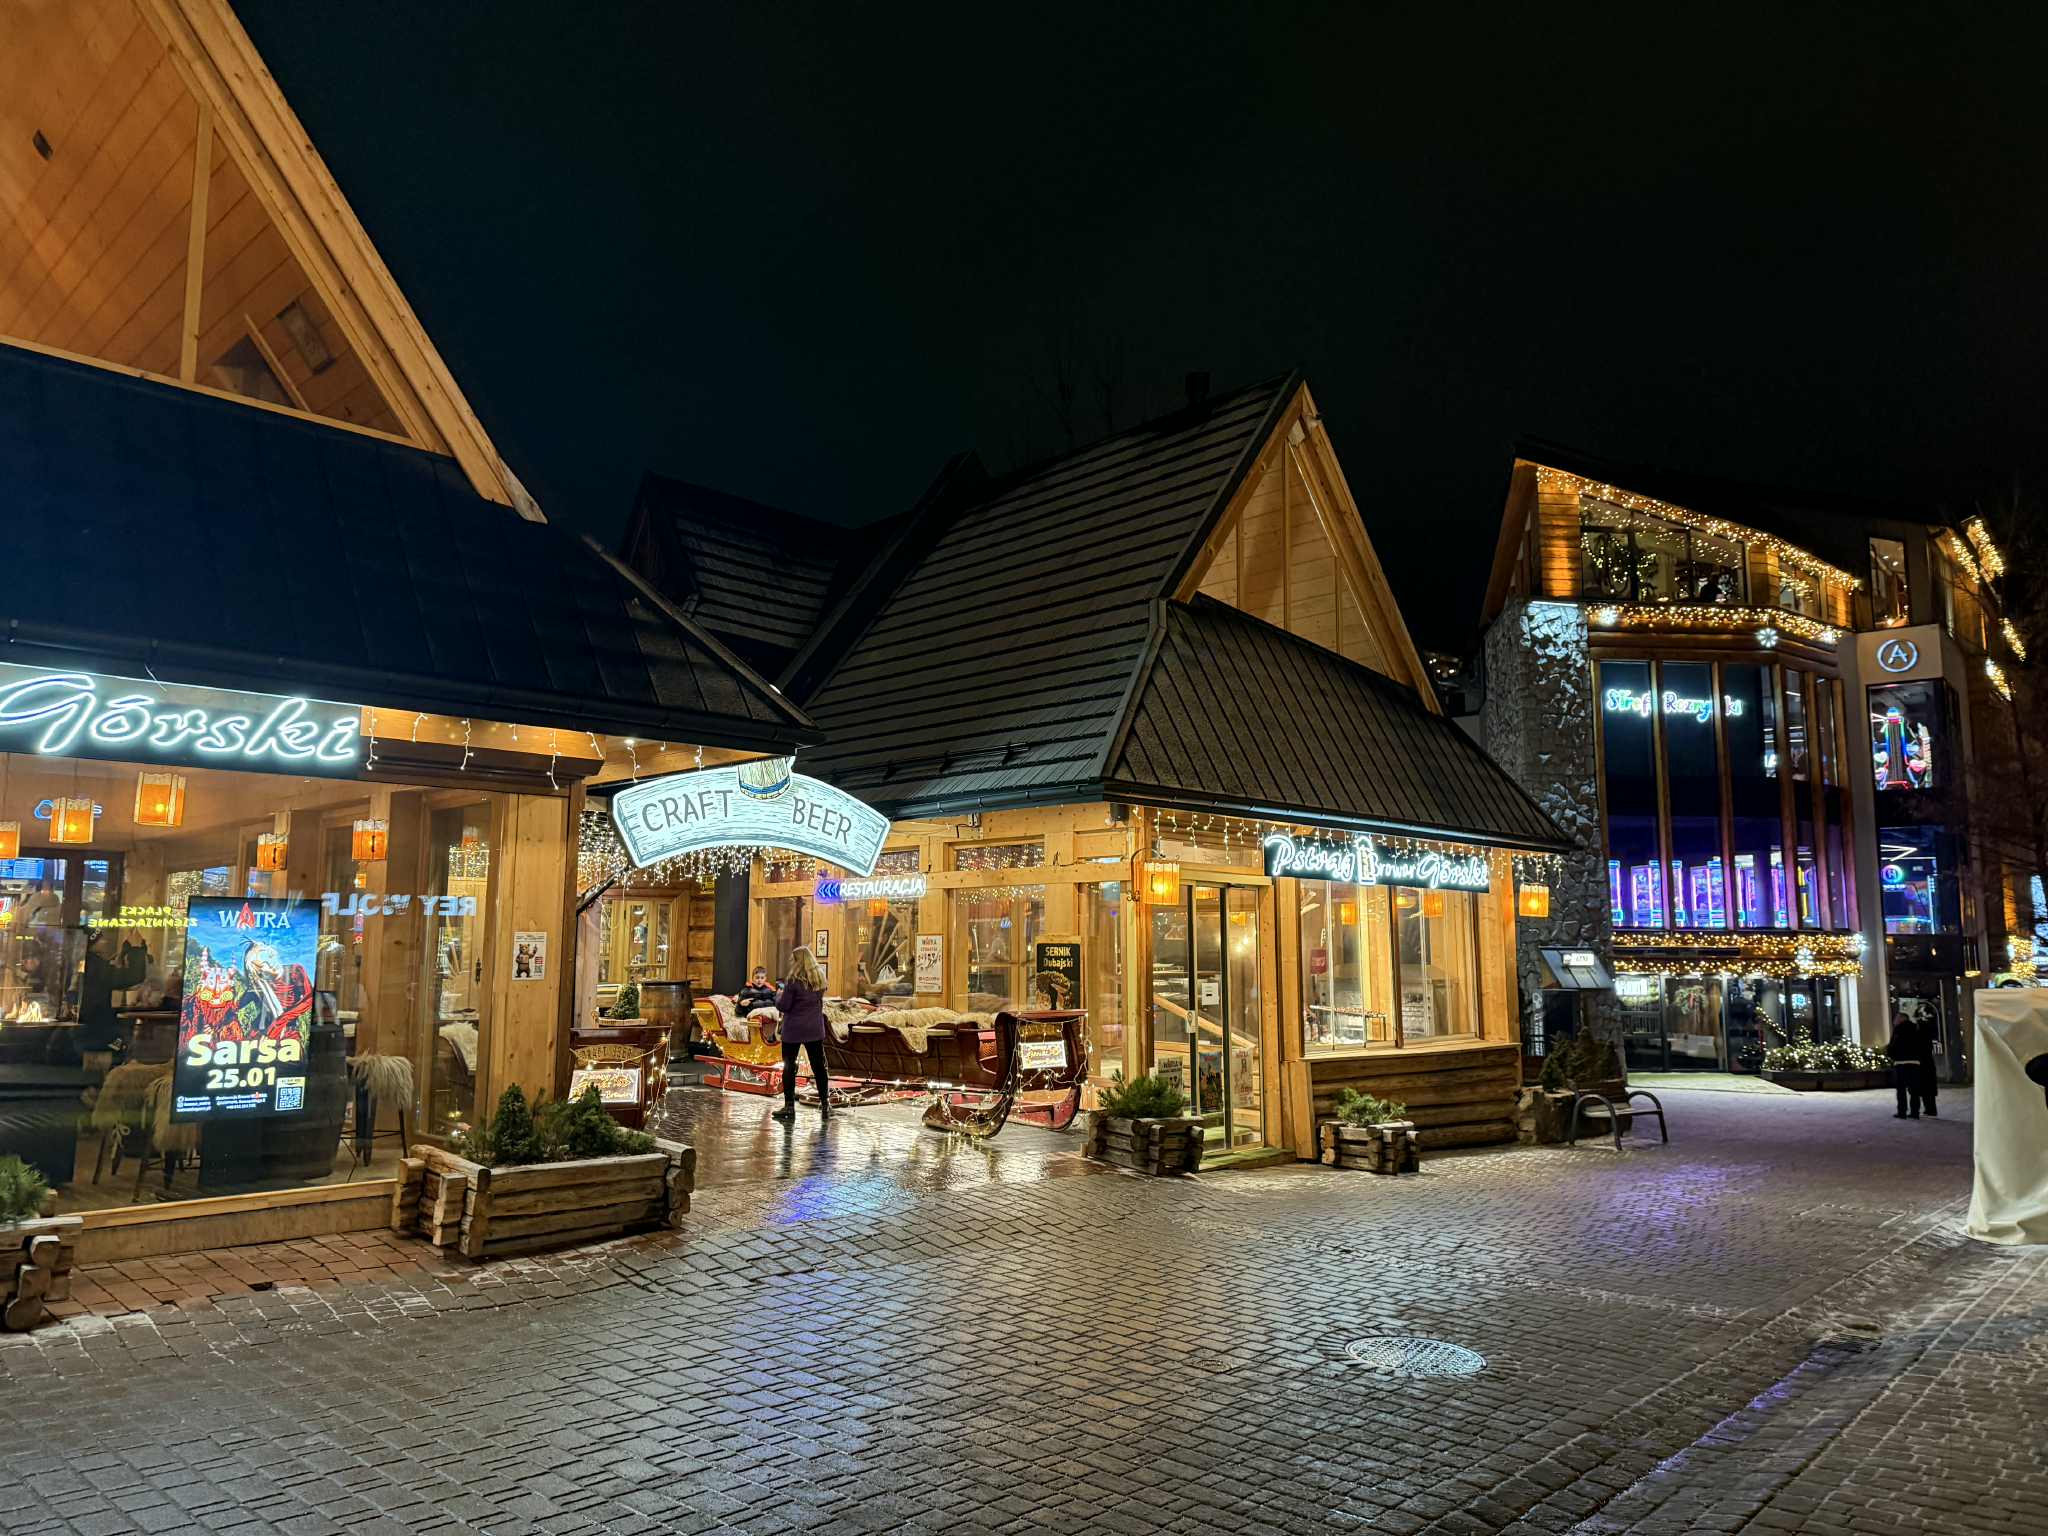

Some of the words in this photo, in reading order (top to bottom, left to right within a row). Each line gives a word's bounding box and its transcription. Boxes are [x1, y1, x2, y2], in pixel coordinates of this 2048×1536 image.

[0, 673, 360, 761] Górski
[1606, 688, 1652, 717] Stref
[1662, 691, 1743, 722] Rozryki
[641, 789, 734, 832] CRAFT
[792, 796, 852, 845] BEER
[1416, 853, 1489, 889] Górski
[840, 878, 924, 897] RESTAURACJA
[218, 902, 291, 928] WATRA
[1043, 957, 1073, 970] Dubajski
[1045, 946, 1071, 957] SERNIK
[186, 1033, 300, 1066] Sarsa
[206, 1066, 276, 1089] 25.01
